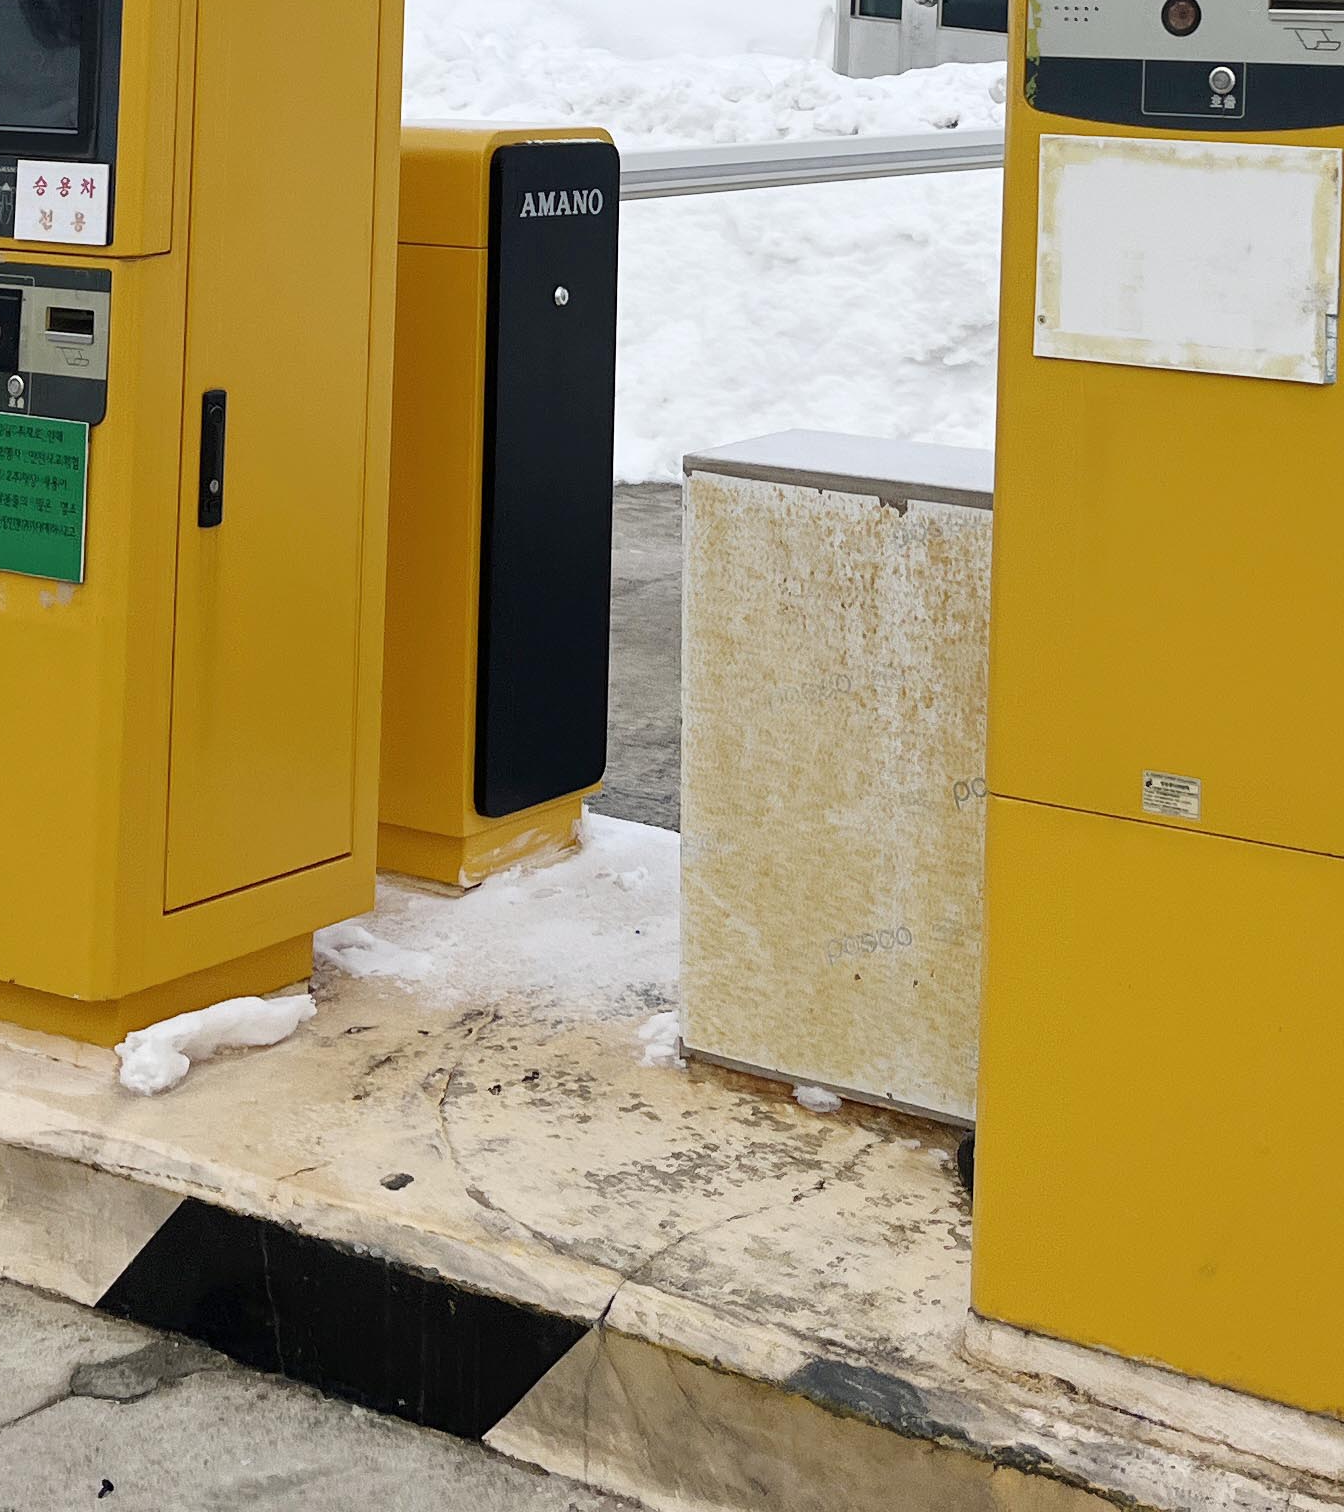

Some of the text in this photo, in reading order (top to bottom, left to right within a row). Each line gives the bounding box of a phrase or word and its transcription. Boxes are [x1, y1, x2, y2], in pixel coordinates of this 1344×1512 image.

[32, 175, 96, 199] 승용차
[520, 188, 604, 218] AMANO
[825, 926, 913, 966] posco
